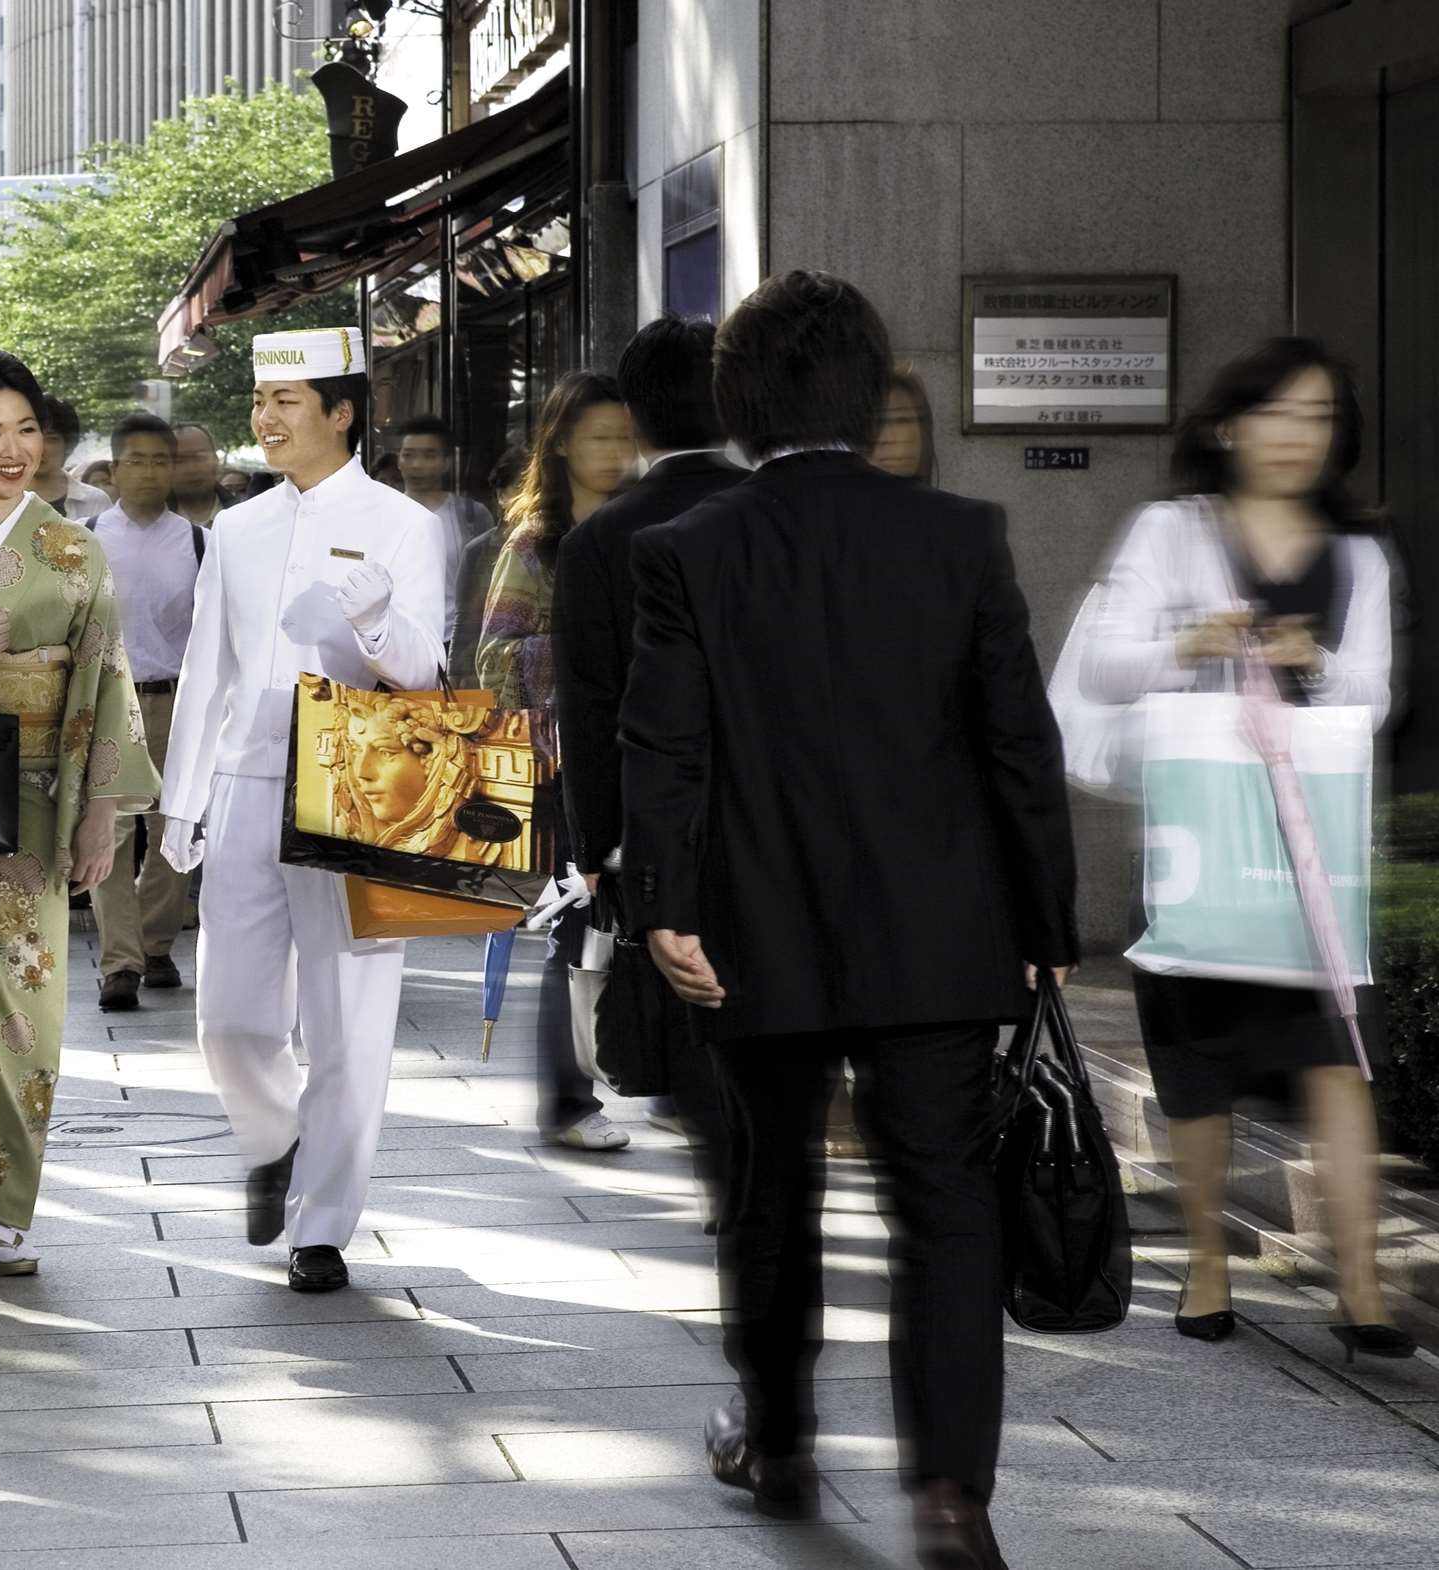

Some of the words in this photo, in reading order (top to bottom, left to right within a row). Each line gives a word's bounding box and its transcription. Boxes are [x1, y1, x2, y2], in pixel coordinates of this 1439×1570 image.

[254, 350, 306, 367] PENINSULA
[984, 356, 1155, 370] 株式会社リクルートスタッフィング
[1037, 410, 1104, 424] みずほ銀行
[1051, 452, 1084, 465] 2-11
